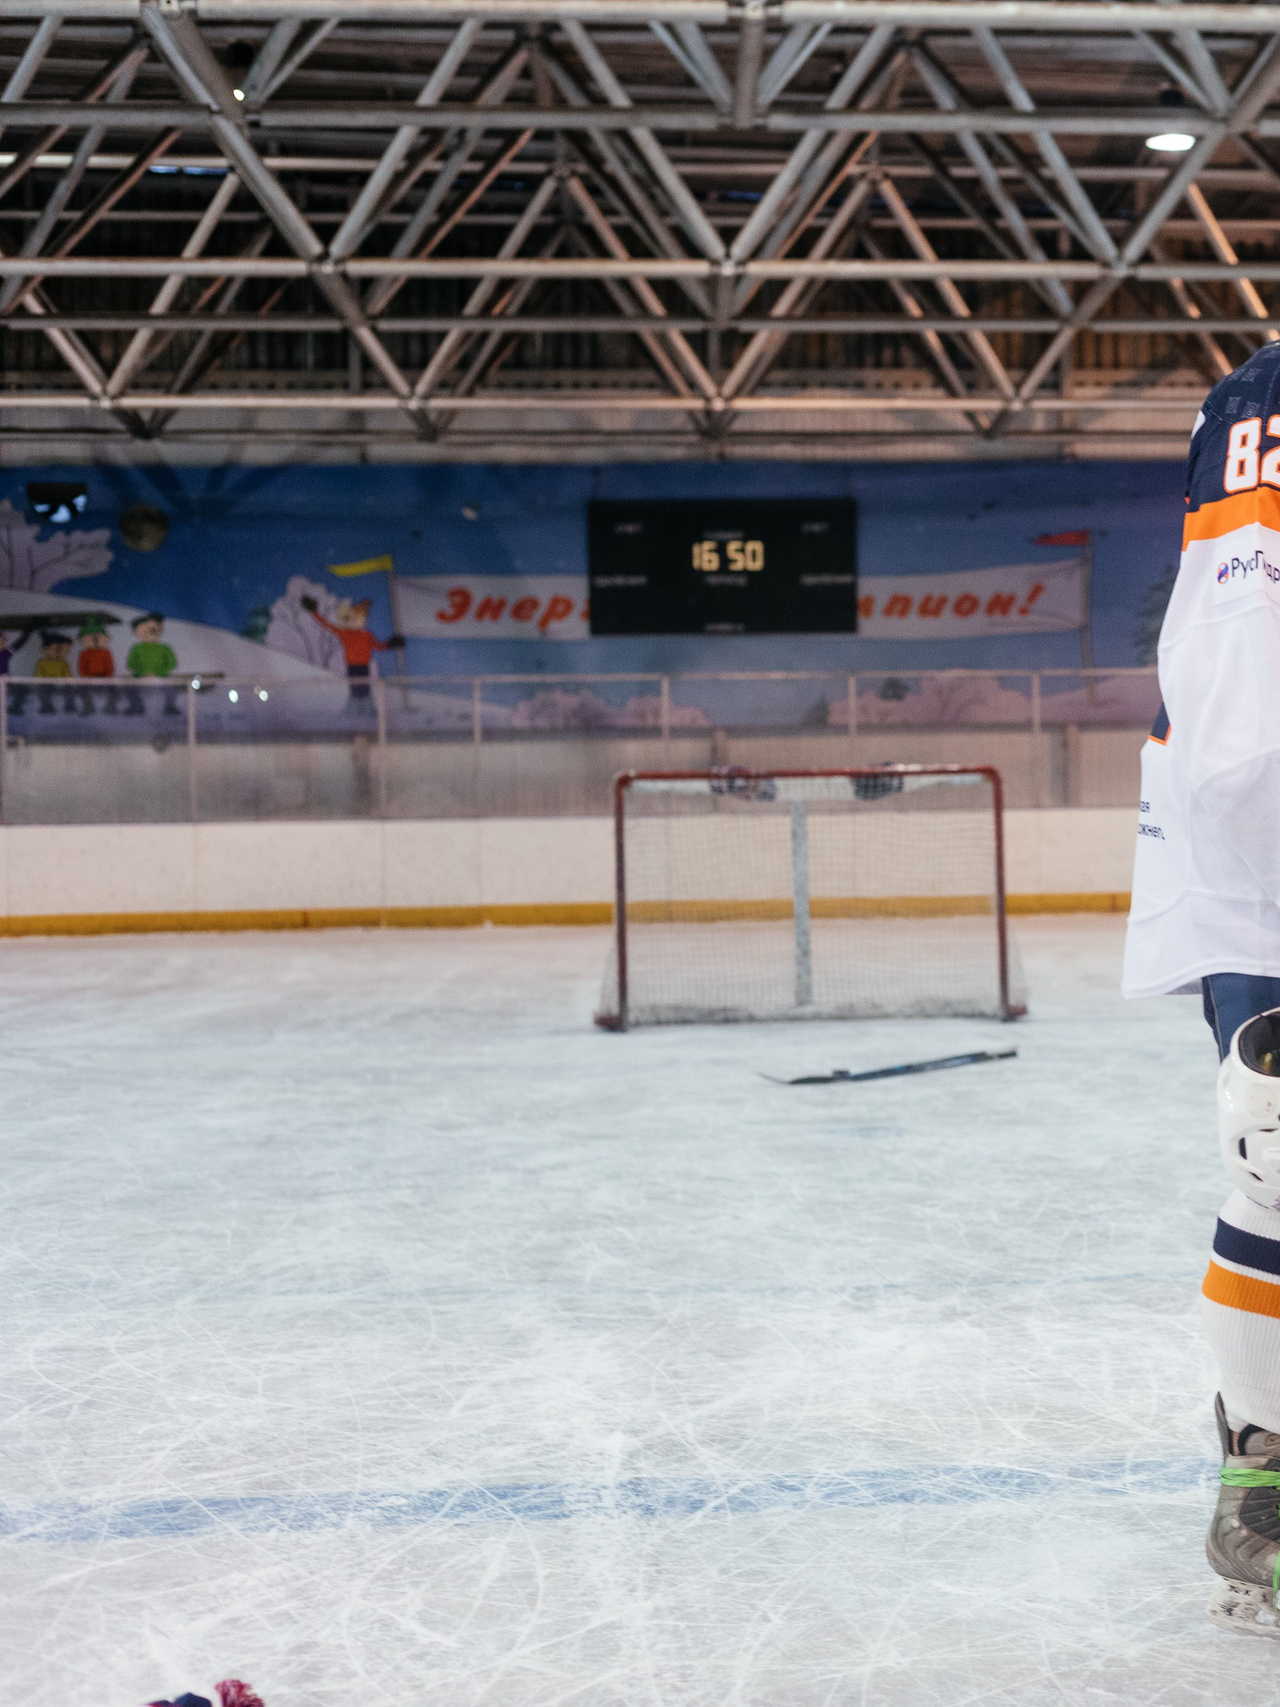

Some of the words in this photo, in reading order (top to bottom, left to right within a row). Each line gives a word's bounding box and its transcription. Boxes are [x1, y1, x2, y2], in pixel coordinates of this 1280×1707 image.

[692, 541, 720, 572] 16
[725, 540, 765, 572] 50
[435, 587, 591, 631] Энер
